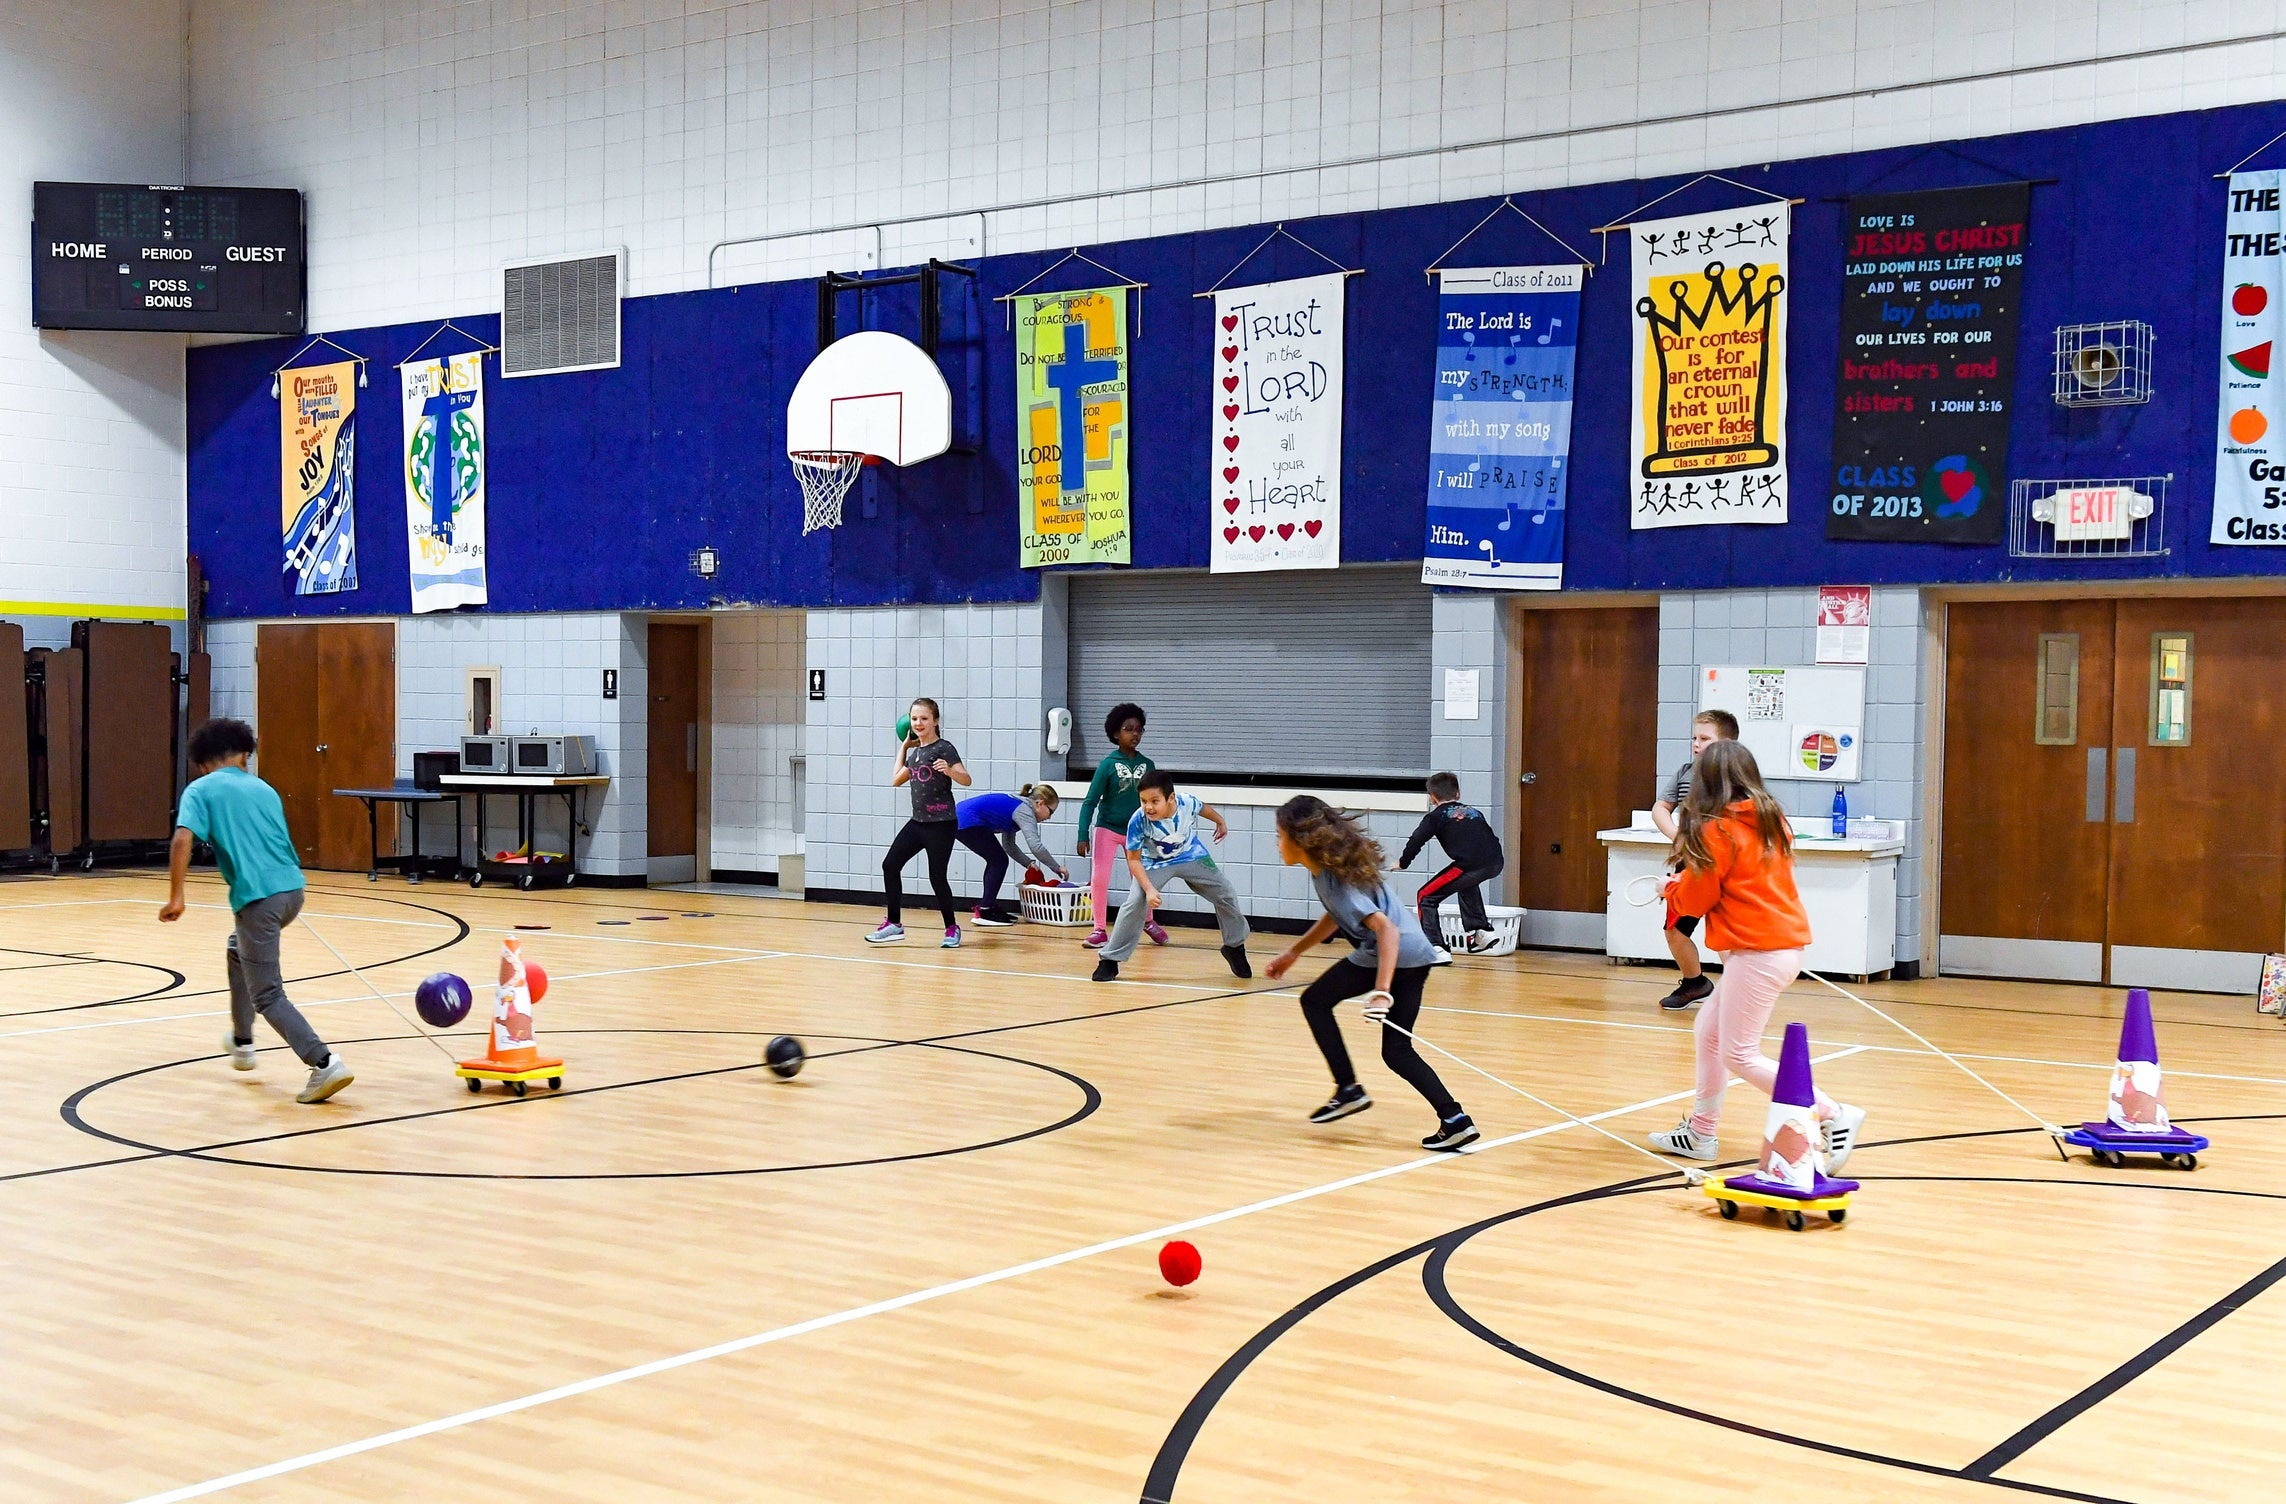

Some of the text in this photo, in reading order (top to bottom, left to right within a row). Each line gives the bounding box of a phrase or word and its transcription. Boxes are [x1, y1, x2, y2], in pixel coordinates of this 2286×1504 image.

[1860, 215, 1915, 228] LOVE IS
[1851, 223, 2023, 257] JESUS CHRIST
[51, 243, 107, 258] HOME
[142, 248, 193, 260] PERIOD
[226, 247, 286, 262] GUEST
[1846, 254, 2023, 275] LAID DOWN HIS LIFE FOR US
[149, 280, 190, 292] POSS.
[1493, 271, 1573, 287] Class of 2011
[1867, 275, 2001, 294] AND WE OUGHT TO
[145, 296, 193, 308] BONUS
[1057, 298, 1092, 309] STRONG
[1446, 312, 1532, 330] The Lord is
[1882, 300, 1981, 328] lay down
[1660, 328, 1765, 352] Our contest
[1855, 331, 1992, 345] OUR LIVES FOR OUR
[1021, 352, 1066, 365] DO NOT BE
[1084, 346, 1124, 360] TERRIFIED
[1266, 345, 1302, 364] in the
[1688, 348, 1745, 367] is for
[426, 356, 479, 395] TRUST
[1668, 360, 1757, 384] an eternal
[1844, 356, 1998, 380] brothers and
[294, 374, 334, 397] Our mouths
[415, 373, 429, 384] have
[1441, 370, 1568, 395] my STRENGTH;
[315, 383, 338, 397] FILLED
[1243, 361, 1327, 415] LORD
[1684, 384, 1742, 399] crown
[1669, 395, 1750, 419] that will
[1844, 391, 1914, 412] sisters
[1931, 400, 2003, 412] 1 JOHN 3:16
[1083, 407, 1100, 418] FOR
[1275, 406, 1303, 422] with
[1083, 424, 1099, 434] THE
[1446, 419, 1551, 441] with my song
[1665, 421, 1713, 438] never
[1280, 433, 1295, 451] all
[1674, 436, 1730, 449] Corinthians
[1732, 434, 1752, 444] 9:25
[1021, 445, 1062, 465] LORD
[1673, 452, 1747, 469] Class of 2012
[299, 445, 324, 490] JOY
[1272, 460, 1305, 480] your
[1020, 474, 1063, 487] YOUR GOD
[1437, 467, 1557, 493] I will PRAISE
[1838, 465, 1916, 488] CLASS
[1041, 491, 1120, 507] WILL BE WITH YOU
[1249, 475, 1326, 514] Heart
[1832, 494, 1923, 517] OF 2013
[2070, 491, 2117, 524] EXIT
[1042, 508, 1125, 524] WHEREVER YOU GO.
[1024, 533, 1082, 548] CLASS OF
[1090, 530, 1127, 550] JOSHUA
[1430, 525, 1470, 546] Him.
[1040, 548, 1070, 562] 2009
[1425, 567, 1467, 578] Psalm 28:7
[313, 580, 329, 591] Class
[330, 578, 337, 590] of
